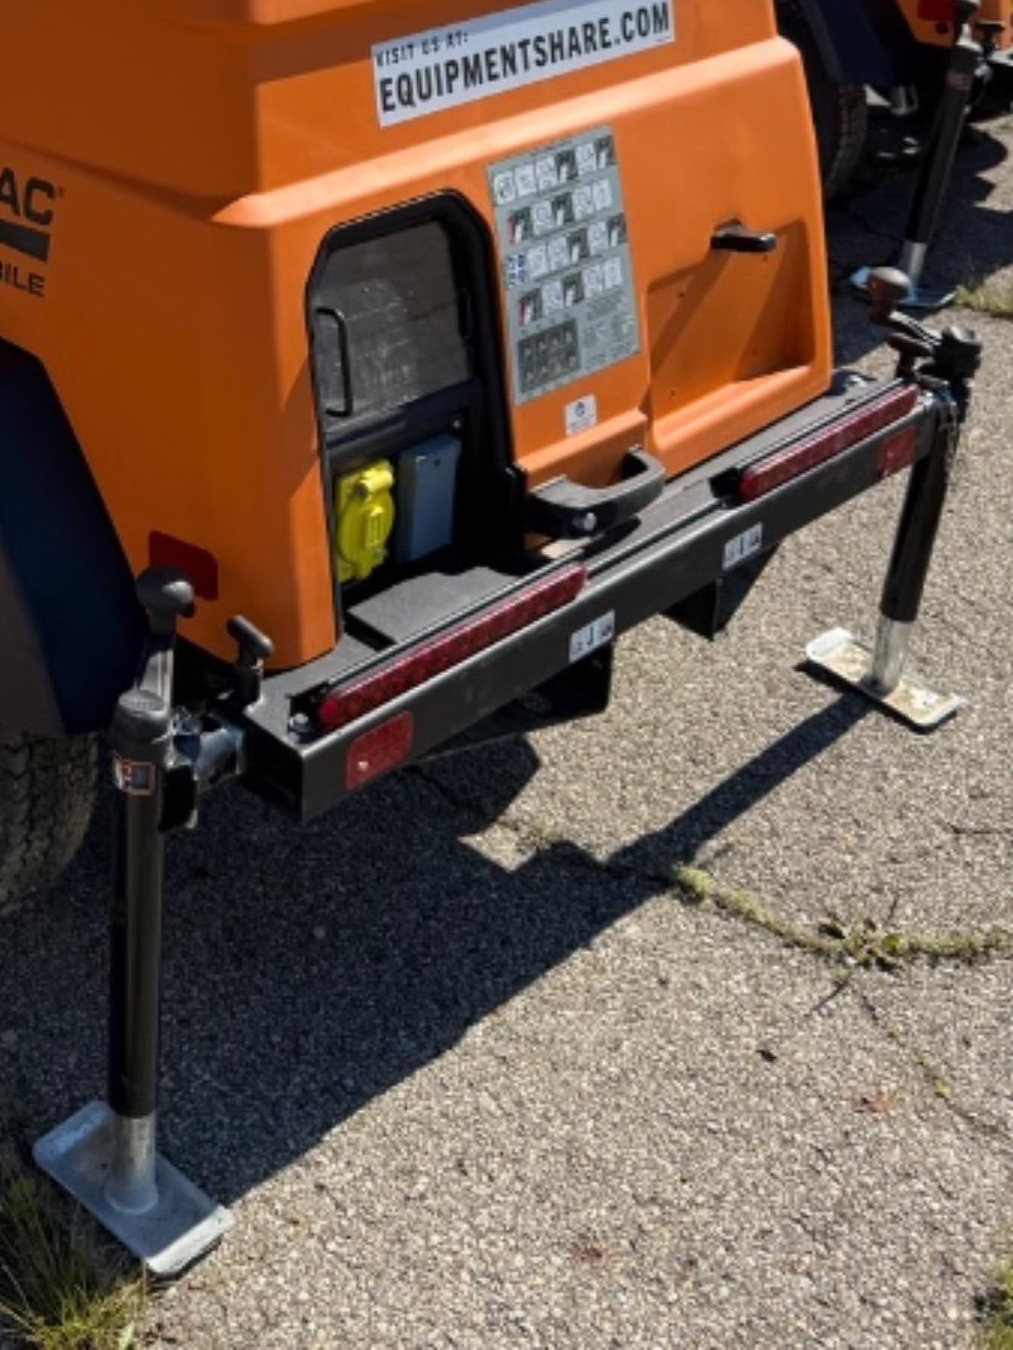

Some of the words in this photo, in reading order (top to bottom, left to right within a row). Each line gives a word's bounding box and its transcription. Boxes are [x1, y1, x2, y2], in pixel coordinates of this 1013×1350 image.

[375, 43, 415, 67] VISIT
[421, 35, 441, 55] US
[446, 29, 469, 49] AT:
[379, 1, 670, 112] EQUIPMENTSHARE.COM
